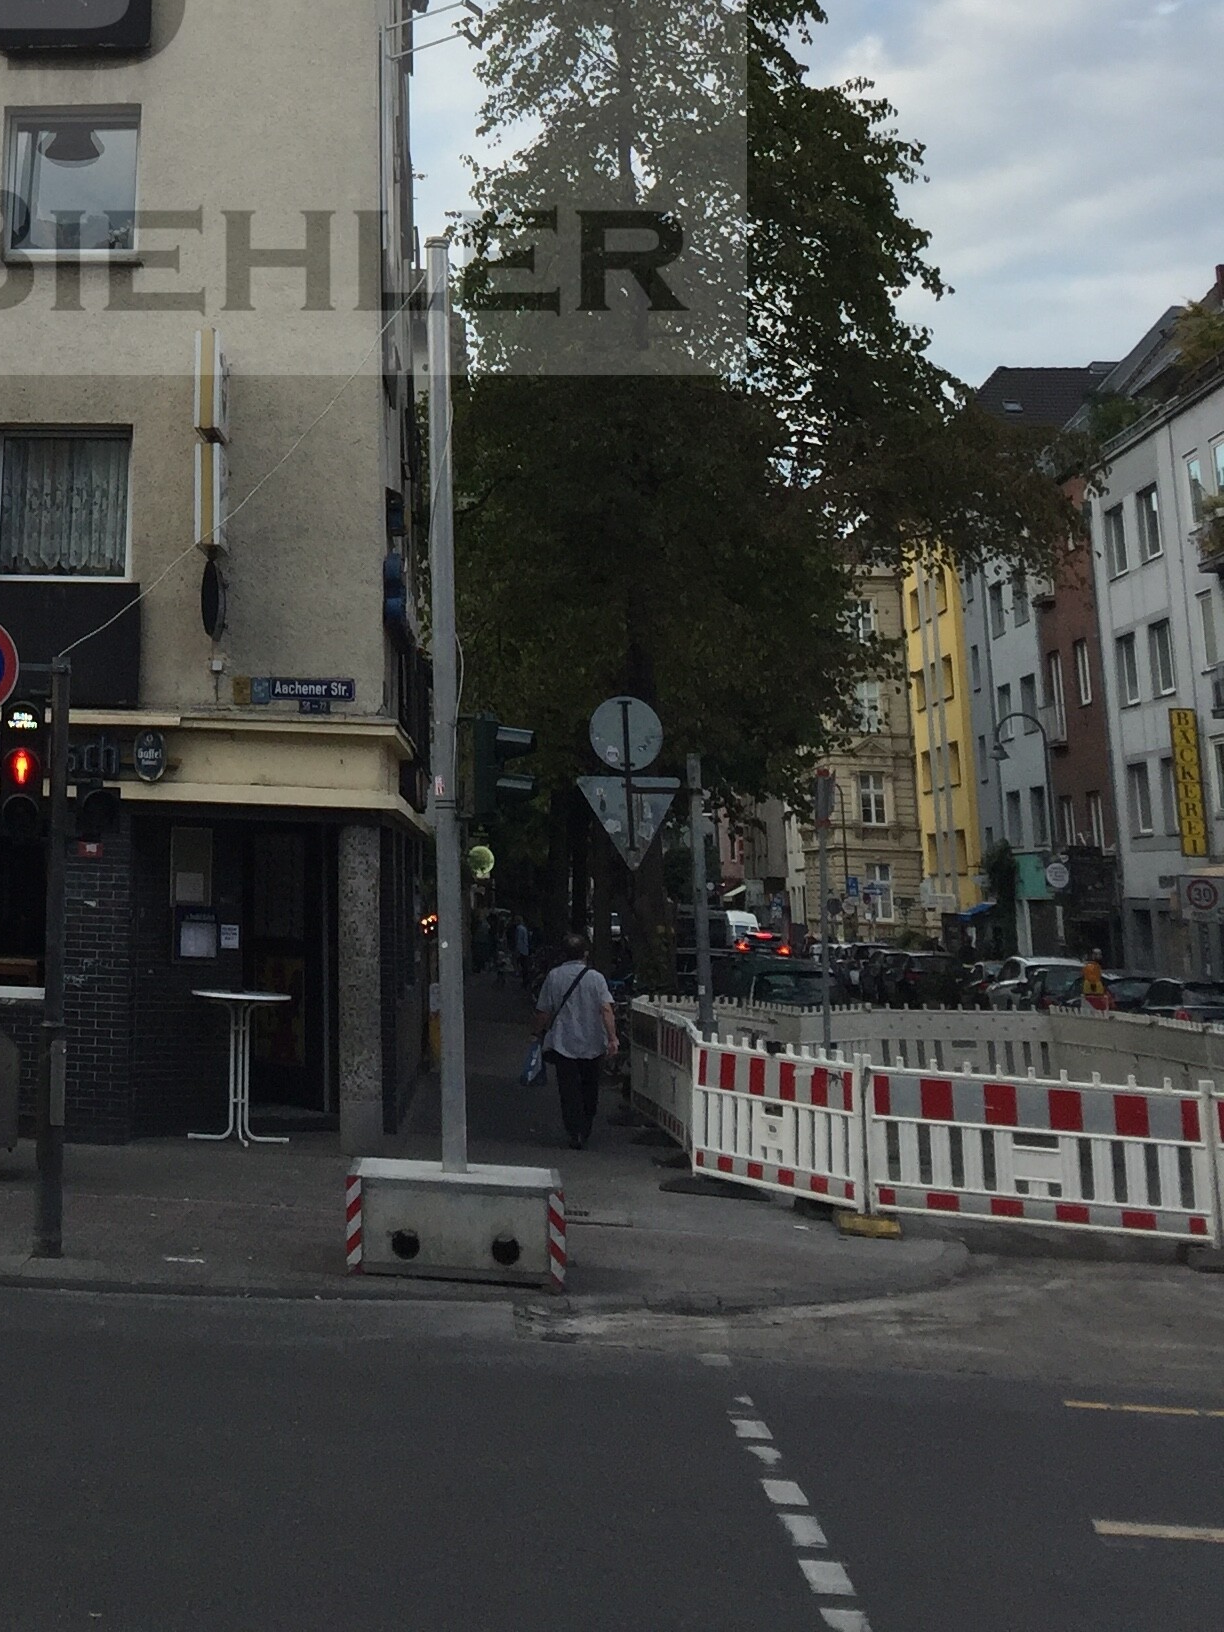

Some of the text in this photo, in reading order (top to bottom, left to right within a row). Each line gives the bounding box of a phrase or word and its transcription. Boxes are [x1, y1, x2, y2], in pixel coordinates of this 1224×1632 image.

[274, 681, 328, 696] Aachener
[330, 682, 349, 697] Str.
[1193, 887, 1212, 903] 30
